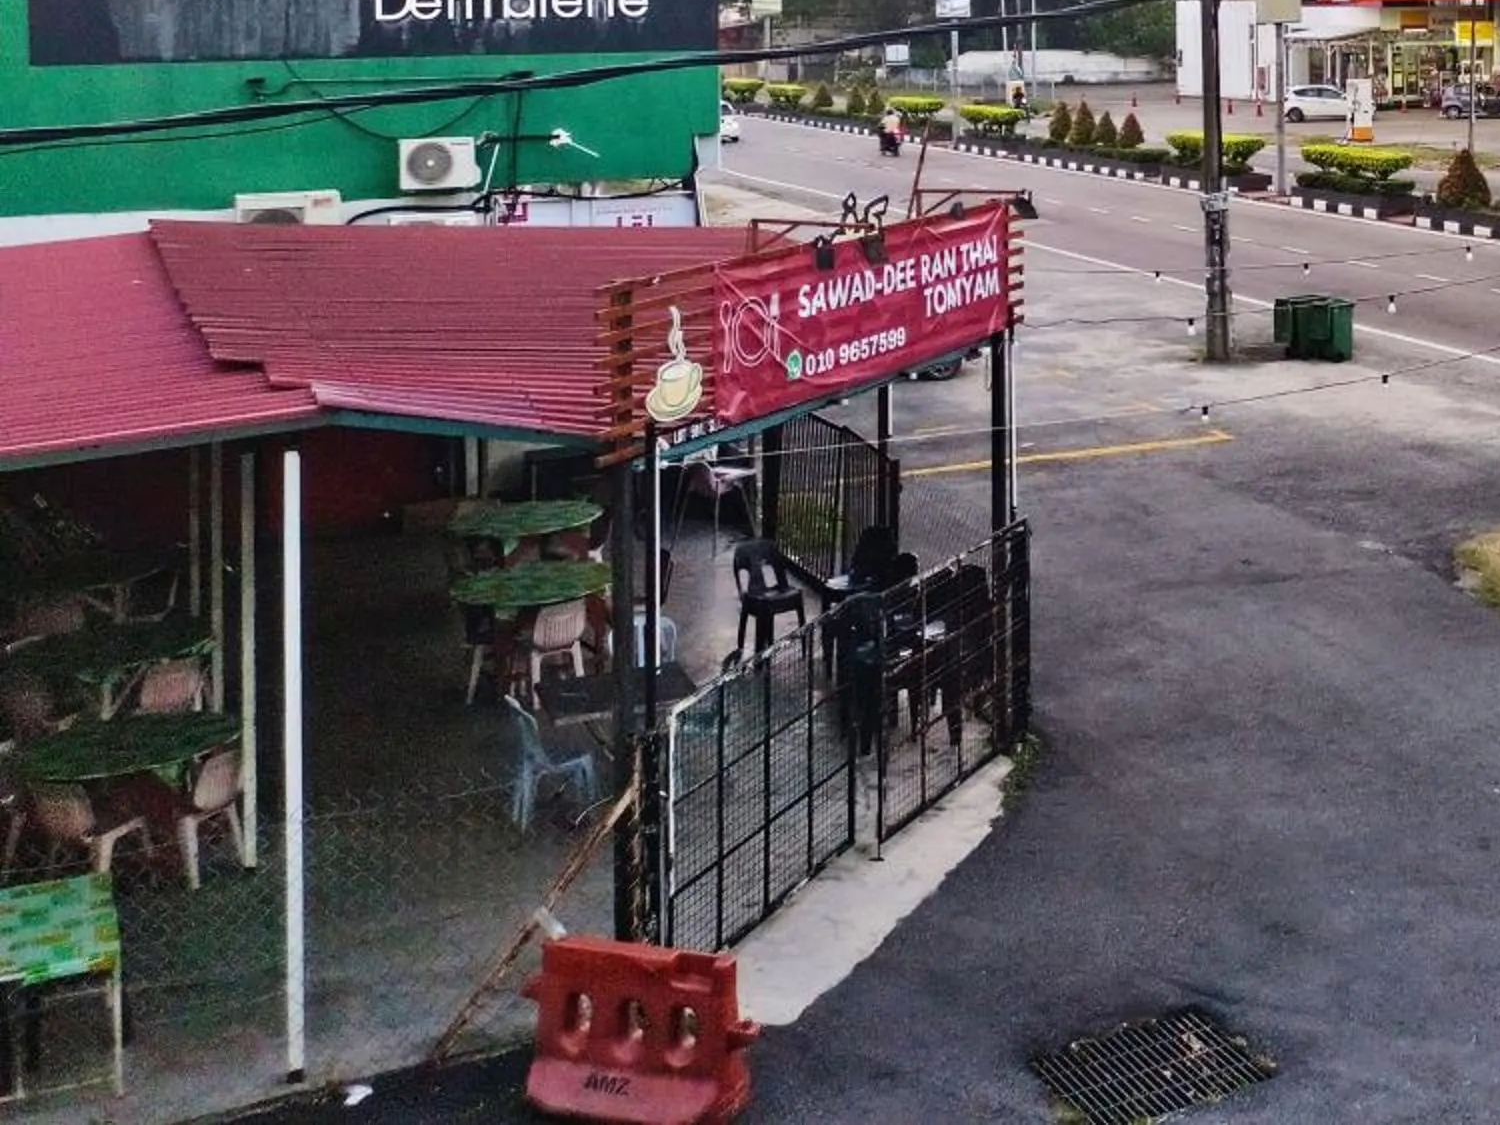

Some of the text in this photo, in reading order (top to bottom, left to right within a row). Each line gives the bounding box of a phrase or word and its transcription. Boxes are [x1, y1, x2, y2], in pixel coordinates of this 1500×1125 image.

[797, 235, 999, 318] SAWAD-DEE RAN THAI
[805, 327, 907, 376] 010 9657599
